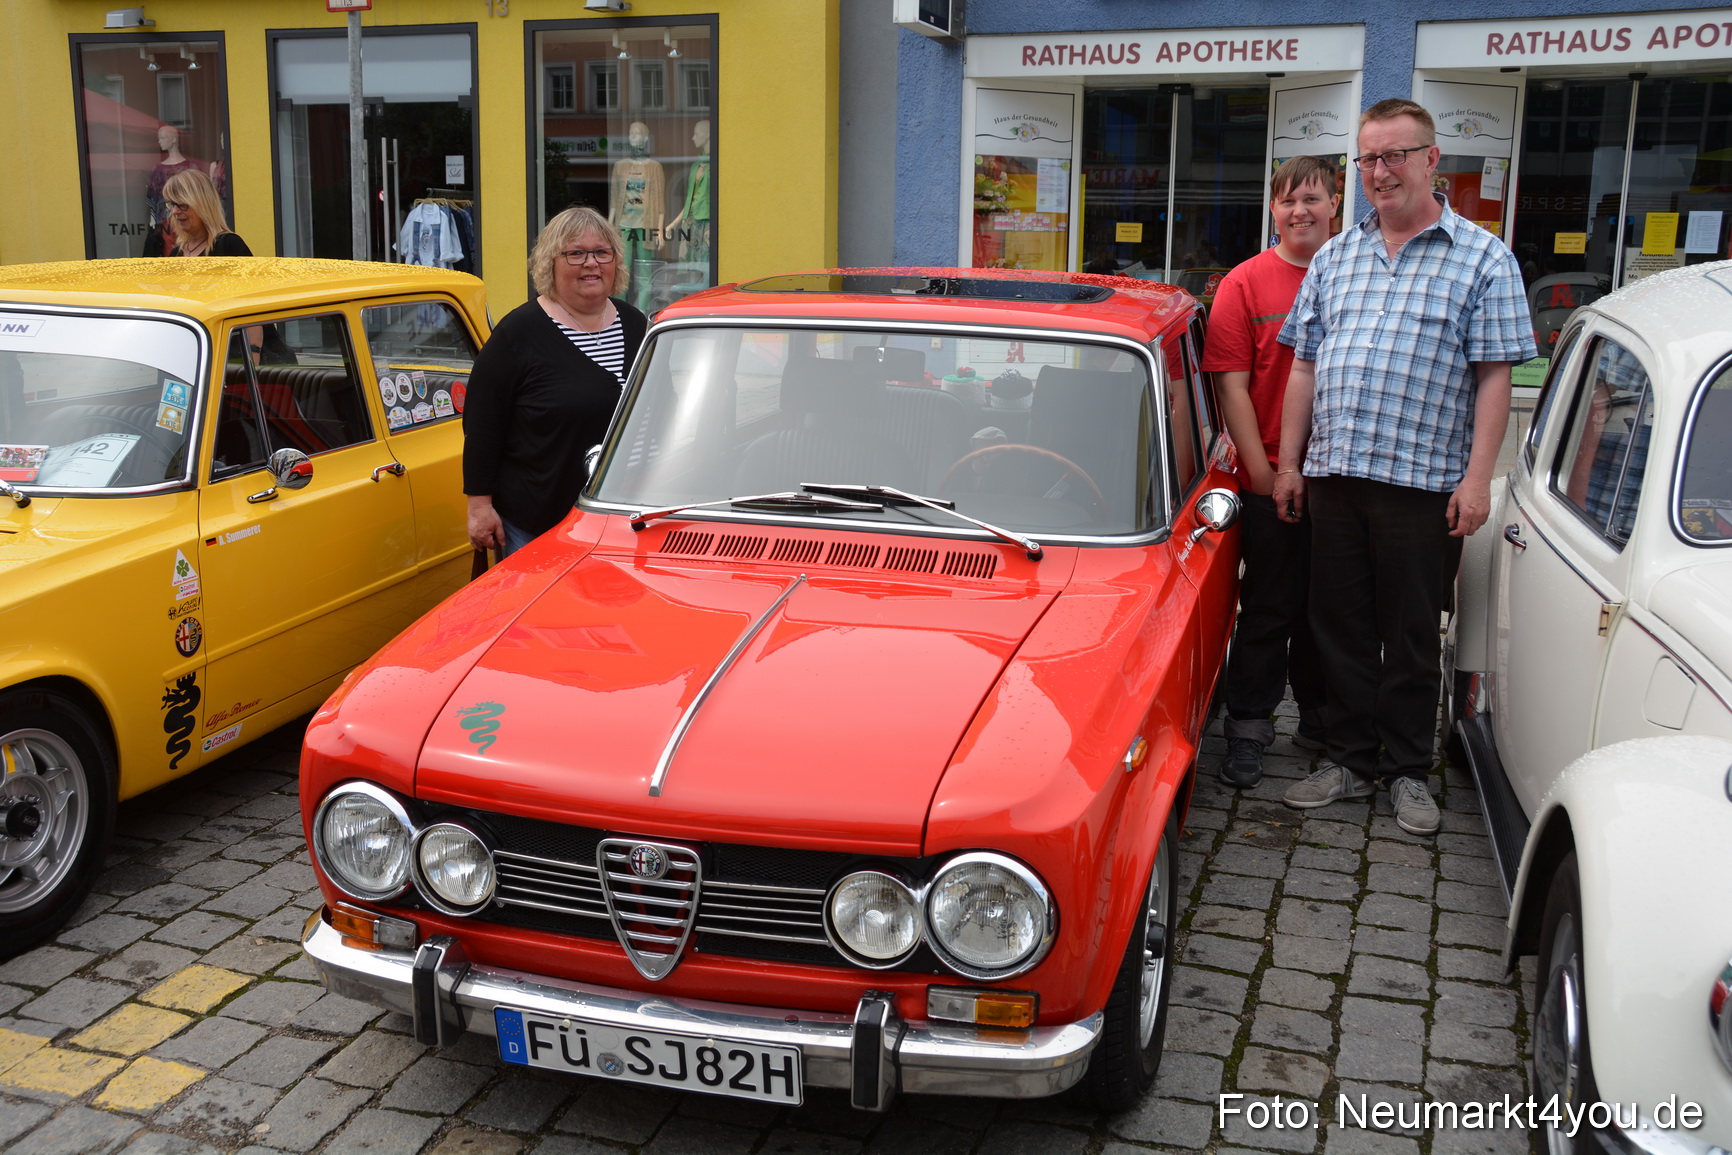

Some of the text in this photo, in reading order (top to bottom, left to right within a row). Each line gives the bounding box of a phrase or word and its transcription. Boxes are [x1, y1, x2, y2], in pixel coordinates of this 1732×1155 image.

[1022, 38, 1299, 66] RATHAUS APOTHEKE
[1486, 27, 1632, 56] RATHAUS
[993, 113, 1059, 128] Haus der Gesundheit
[1438, 108, 1501, 124] Haus der Gesundheit
[108, 223, 171, 236] TAIFN
[620, 228, 691, 241] AIFUN
[218, 524, 261, 546] A. Summerer
[206, 698, 263, 731] Alfa Romeo
[211, 728, 238, 748] Castrol
[509, 1041, 519, 1054] D
[526, 1020, 591, 1068] FÜ
